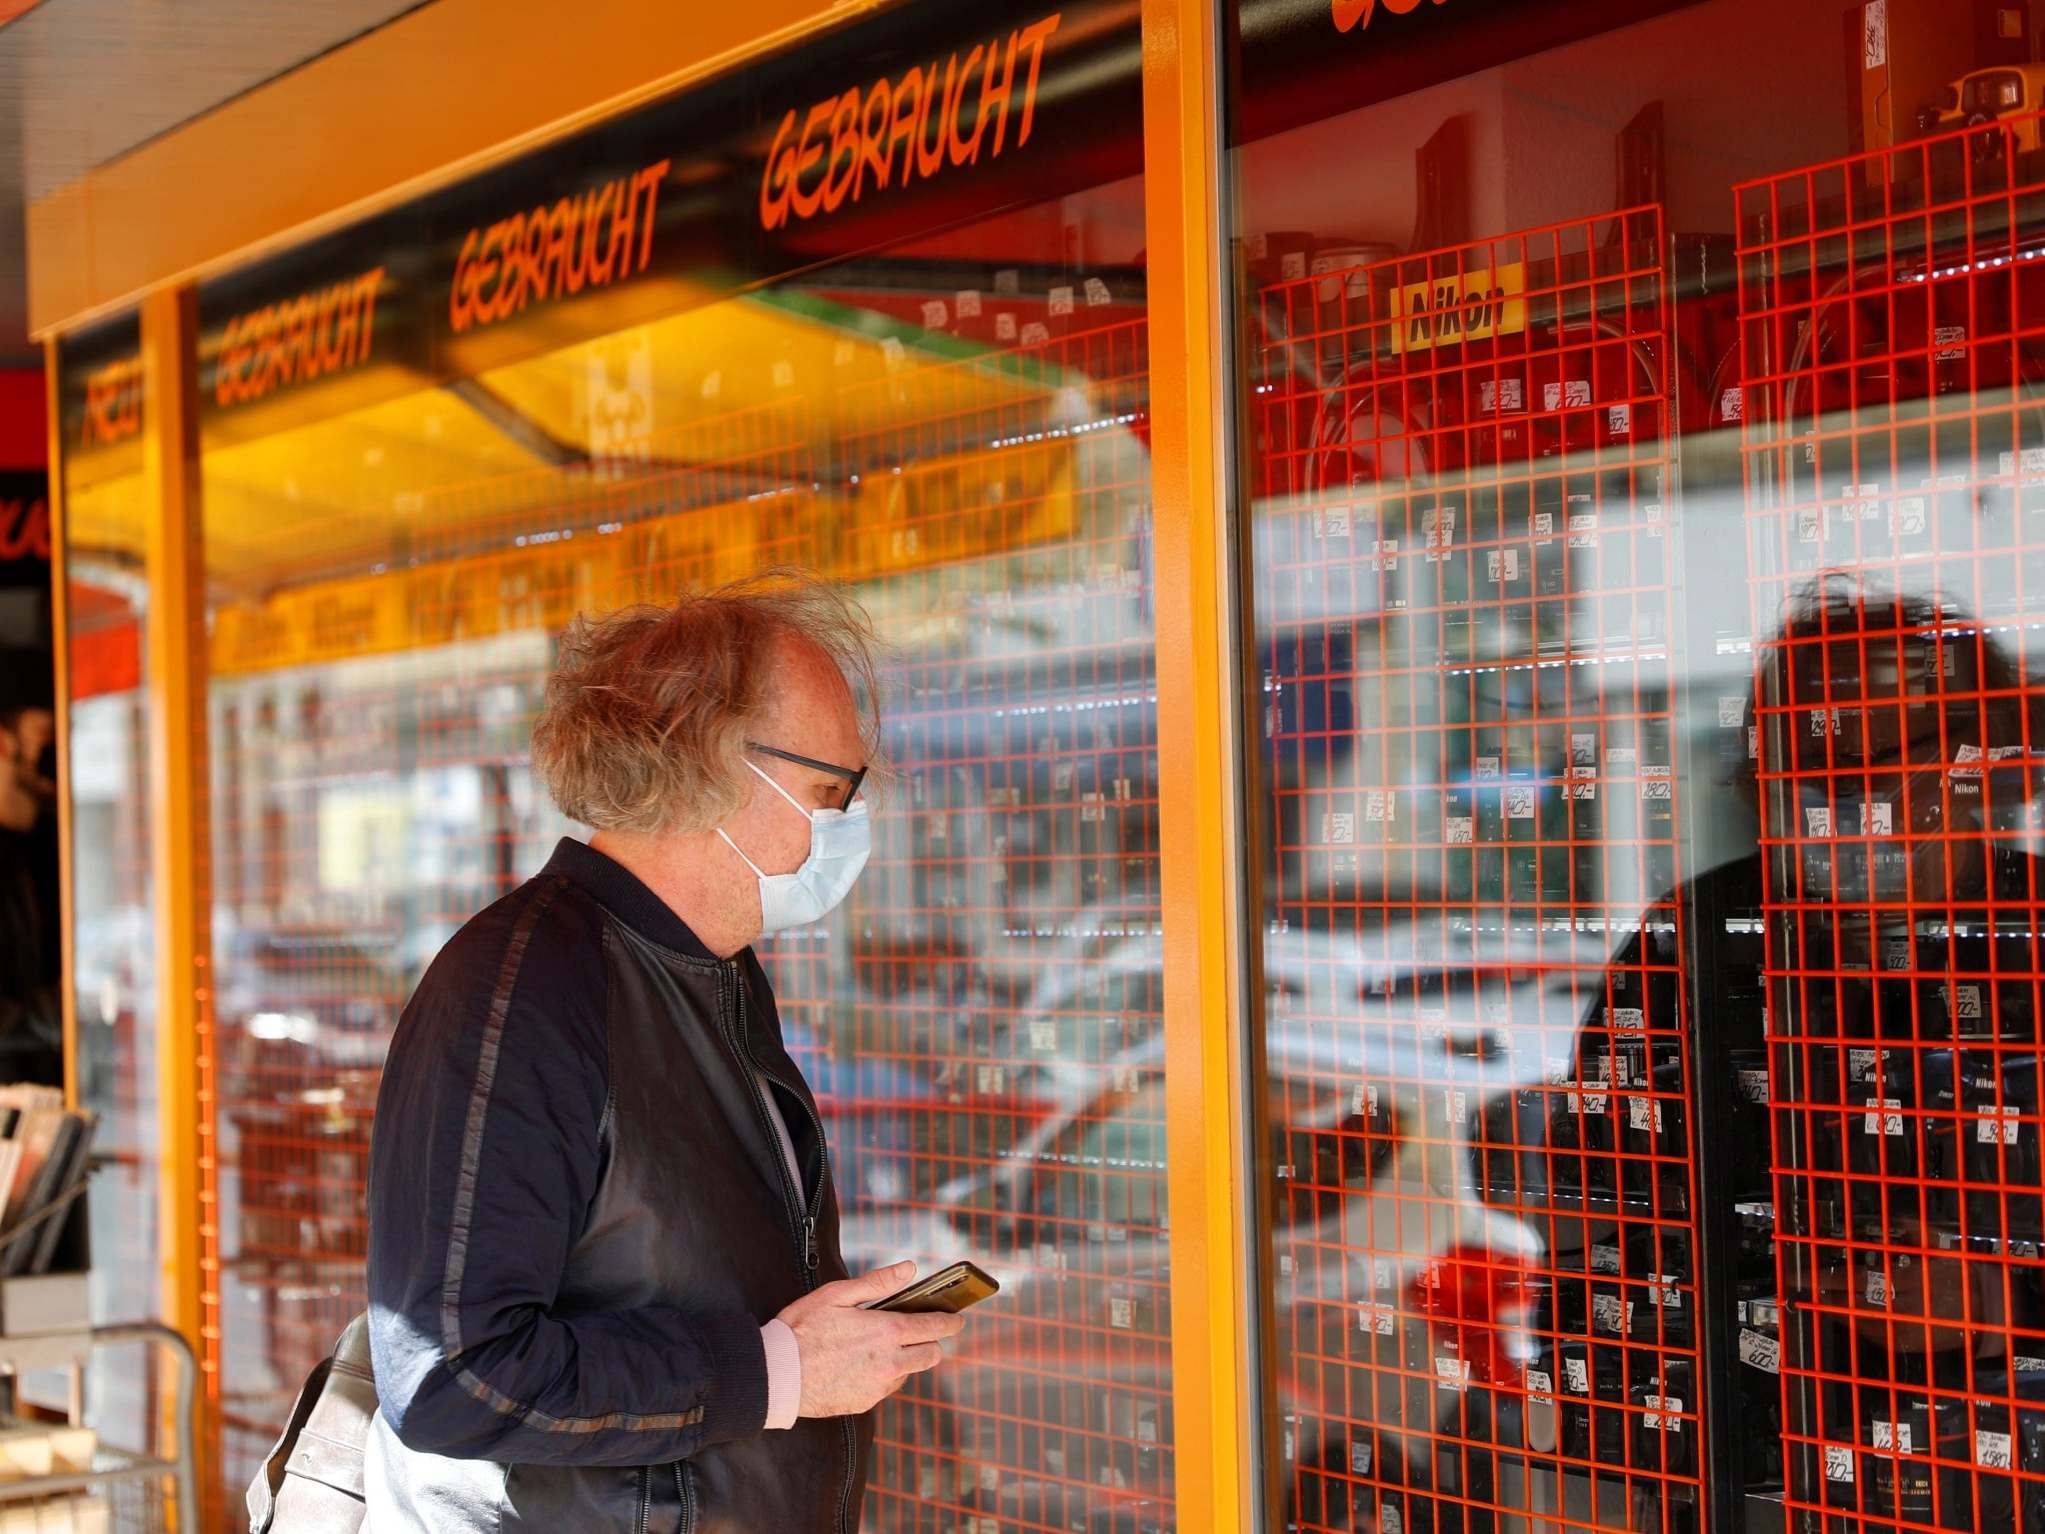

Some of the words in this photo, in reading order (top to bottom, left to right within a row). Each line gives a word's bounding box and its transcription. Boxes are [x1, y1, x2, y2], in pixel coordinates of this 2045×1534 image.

[760, 13, 1061, 231] GEBRAUCHT
[451, 158, 671, 332] GEBRAUCHT
[1410, 286, 1505, 342] Nikon
[216, 267, 385, 406] GEBRAUCHT
[1954, 783, 1979, 795] Nikon
